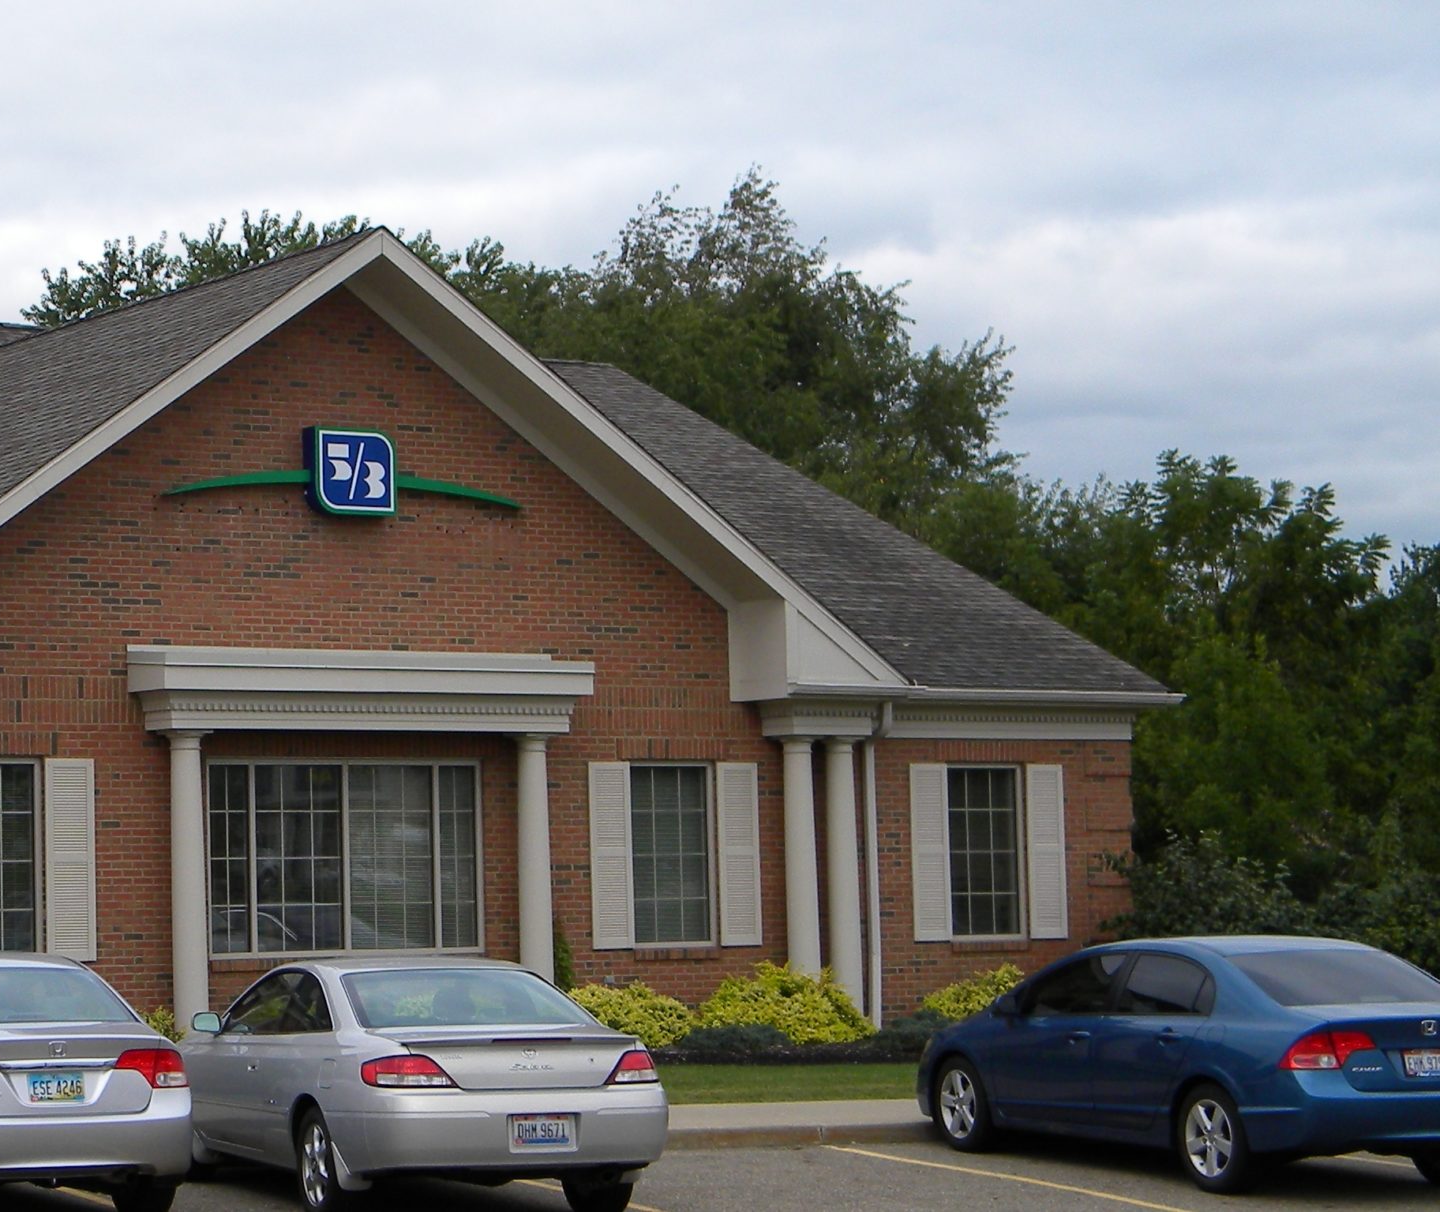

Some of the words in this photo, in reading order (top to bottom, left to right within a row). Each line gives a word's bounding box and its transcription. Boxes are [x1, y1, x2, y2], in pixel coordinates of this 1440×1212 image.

[327, 442, 386, 500] 5/3
[33, 1080, 52, 1096] ESE
[56, 1080, 82, 1097] 4246
[540, 1122, 566, 1138] 9671
